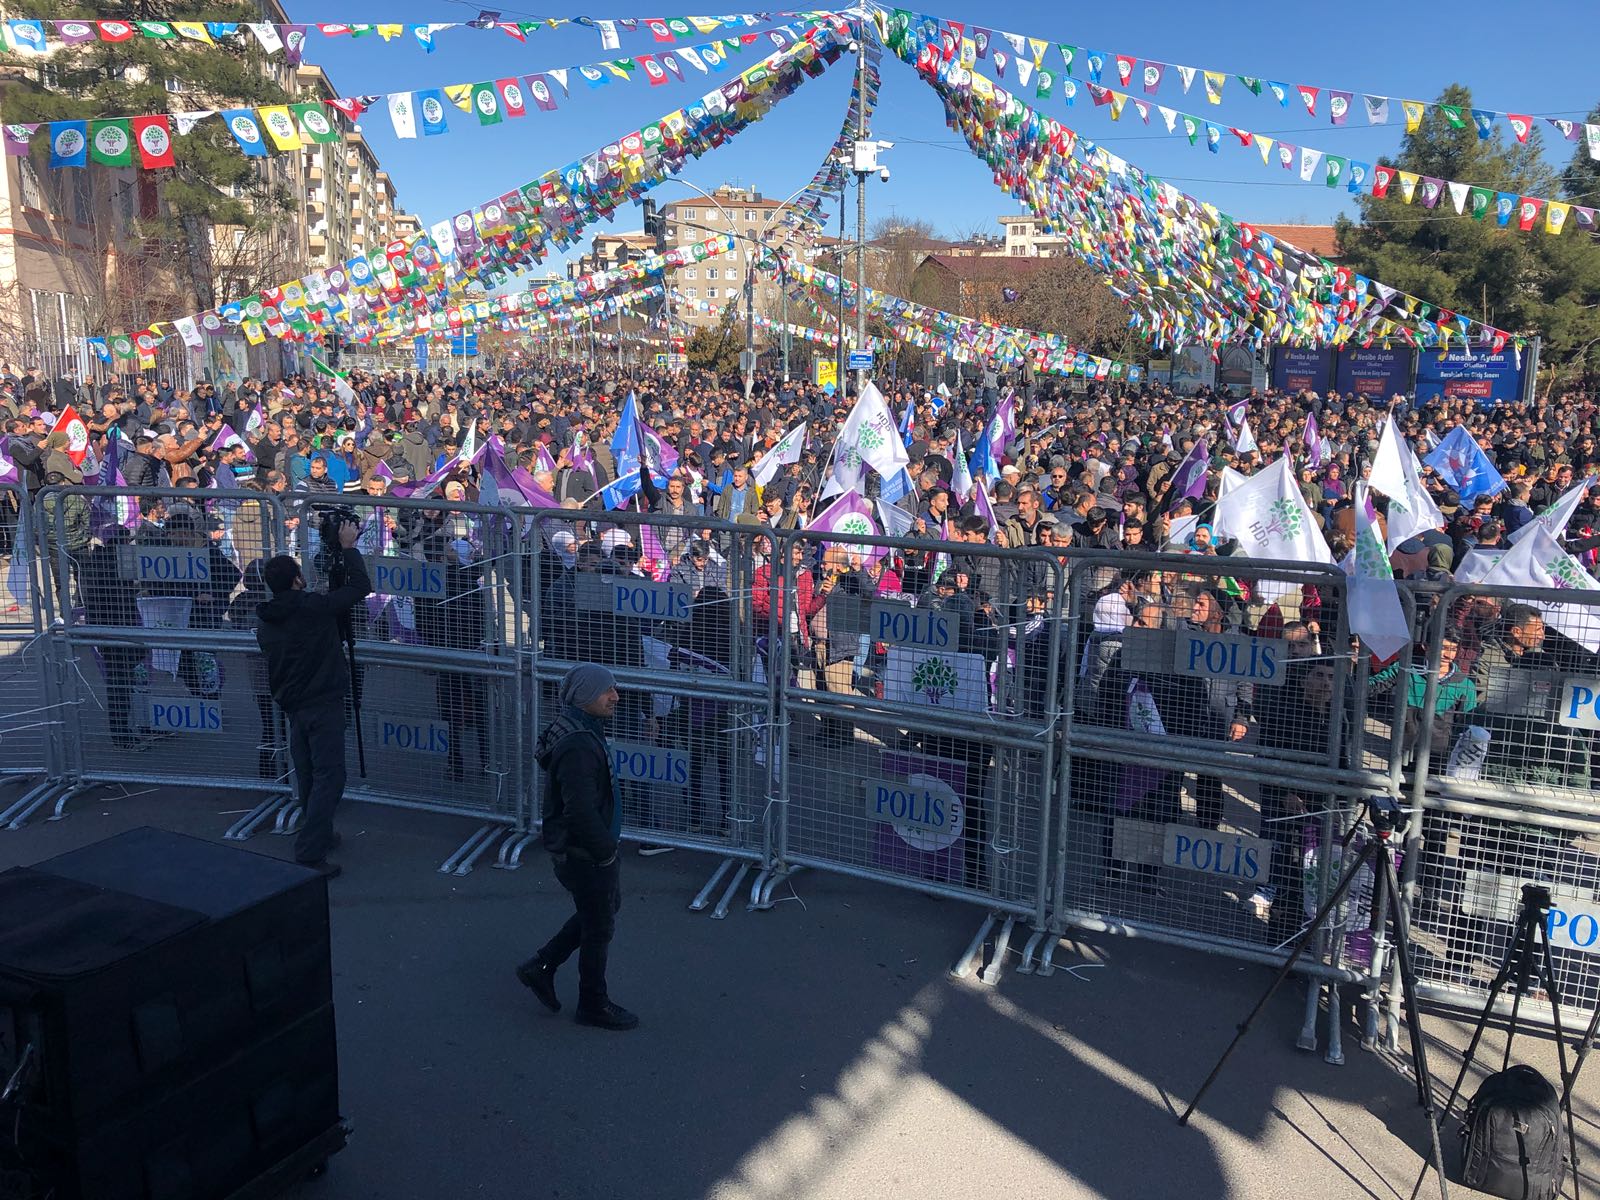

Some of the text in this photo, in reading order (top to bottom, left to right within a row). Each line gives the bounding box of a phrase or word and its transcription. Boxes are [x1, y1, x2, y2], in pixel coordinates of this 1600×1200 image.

[1480, 353, 1504, 363] Aydın
[1248, 521, 1270, 548] HDP
[138, 551, 210, 582] POLİS
[376, 561, 443, 594] POLİS
[616, 583, 690, 620] POLİS
[878, 612, 950, 648] POLİS
[1187, 637, 1277, 681] POLİS
[153, 701, 221, 730] POLİS
[382, 721, 449, 754] POLİS
[615, 750, 688, 784] POLİS
[876, 786, 945, 827] POLİS
[1174, 833, 1260, 880] POLİS
